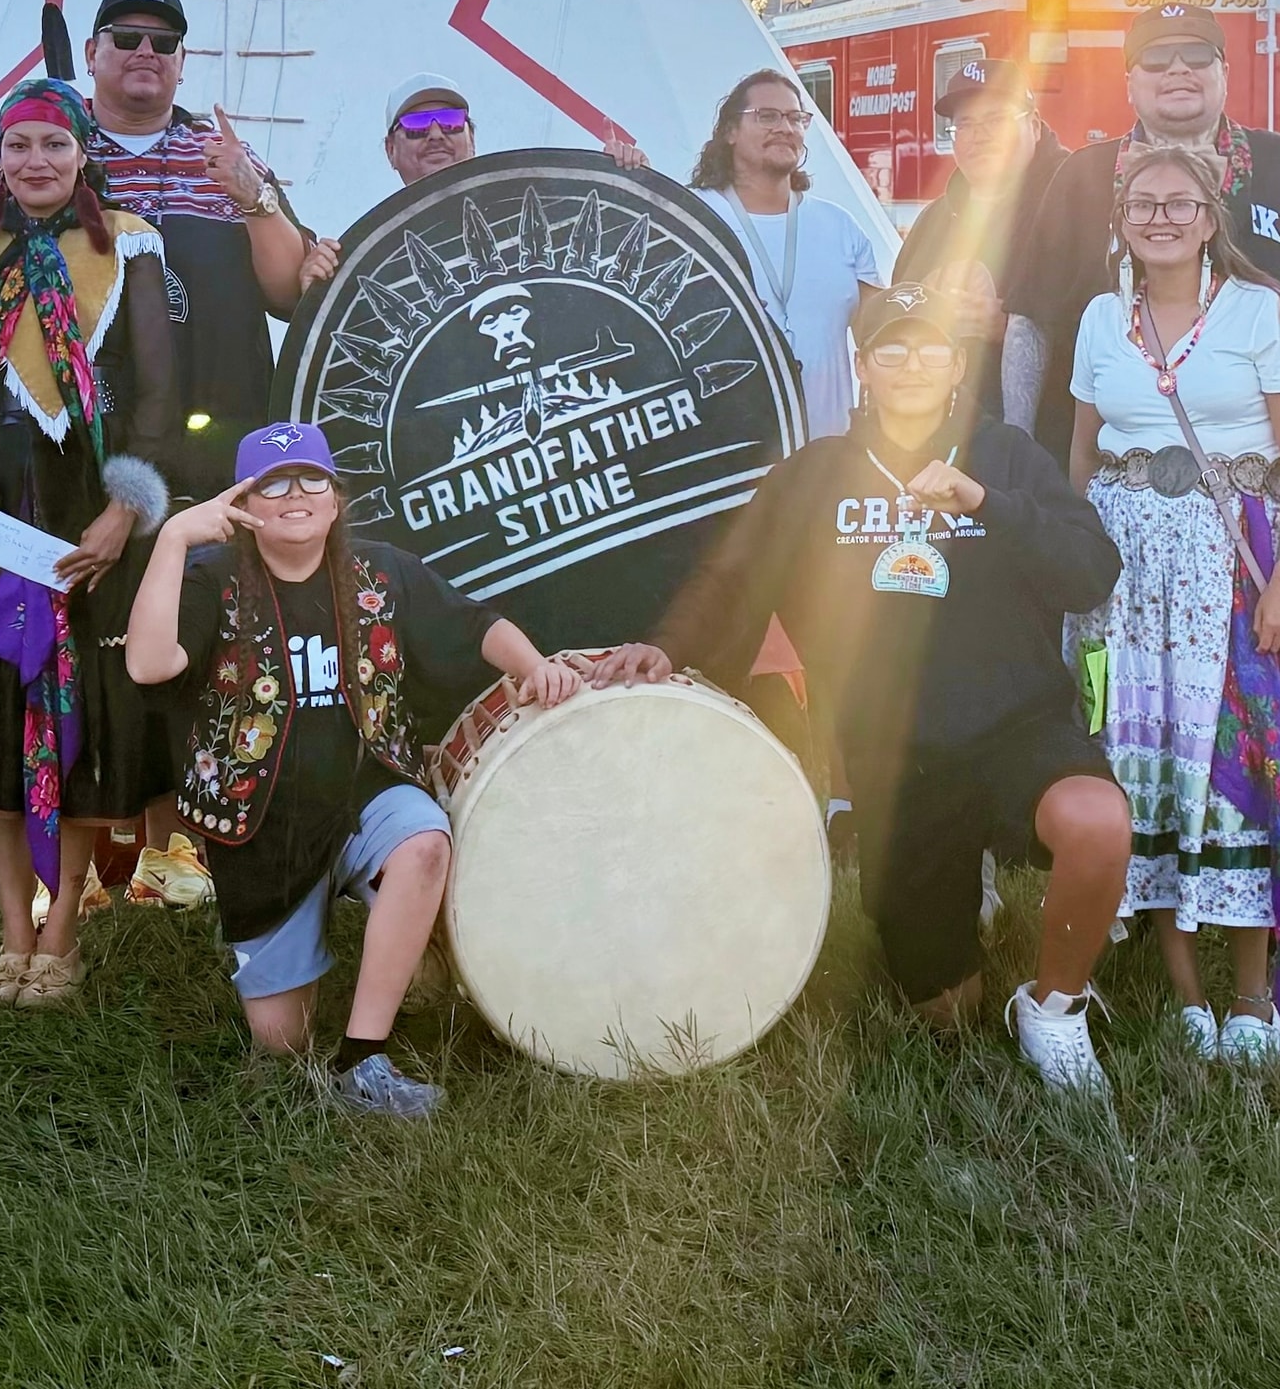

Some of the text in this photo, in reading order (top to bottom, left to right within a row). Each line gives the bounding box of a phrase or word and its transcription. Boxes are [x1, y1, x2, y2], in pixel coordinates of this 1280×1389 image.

[866, 64, 897, 87] MOBILE
[849, 91, 916, 117] COMMAND POST
[400, 388, 702, 532] GRANDFATHER
[496, 463, 636, 547] STONE
[836, 535, 870, 545] CREATOR
[874, 535, 899, 544] RULES
[955, 529, 987, 538] AROUND
[310, 694, 333, 708] FM
